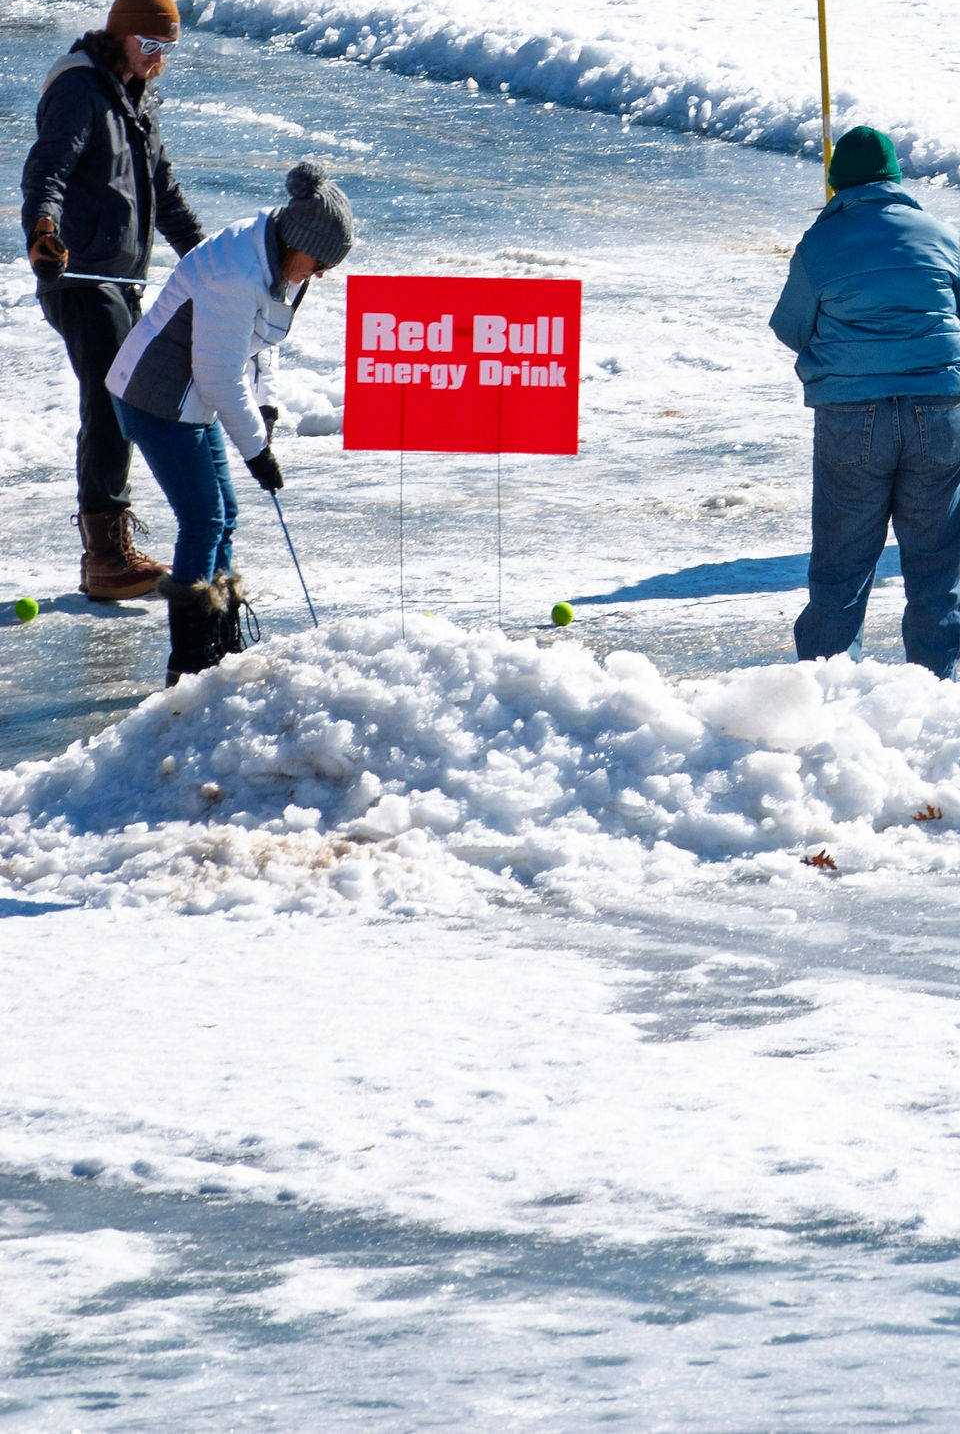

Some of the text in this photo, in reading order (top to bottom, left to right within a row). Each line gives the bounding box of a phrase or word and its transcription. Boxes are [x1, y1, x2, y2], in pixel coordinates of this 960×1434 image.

[362, 312, 564, 355] Red Bull
[357, 357, 567, 390] Energy Drink
